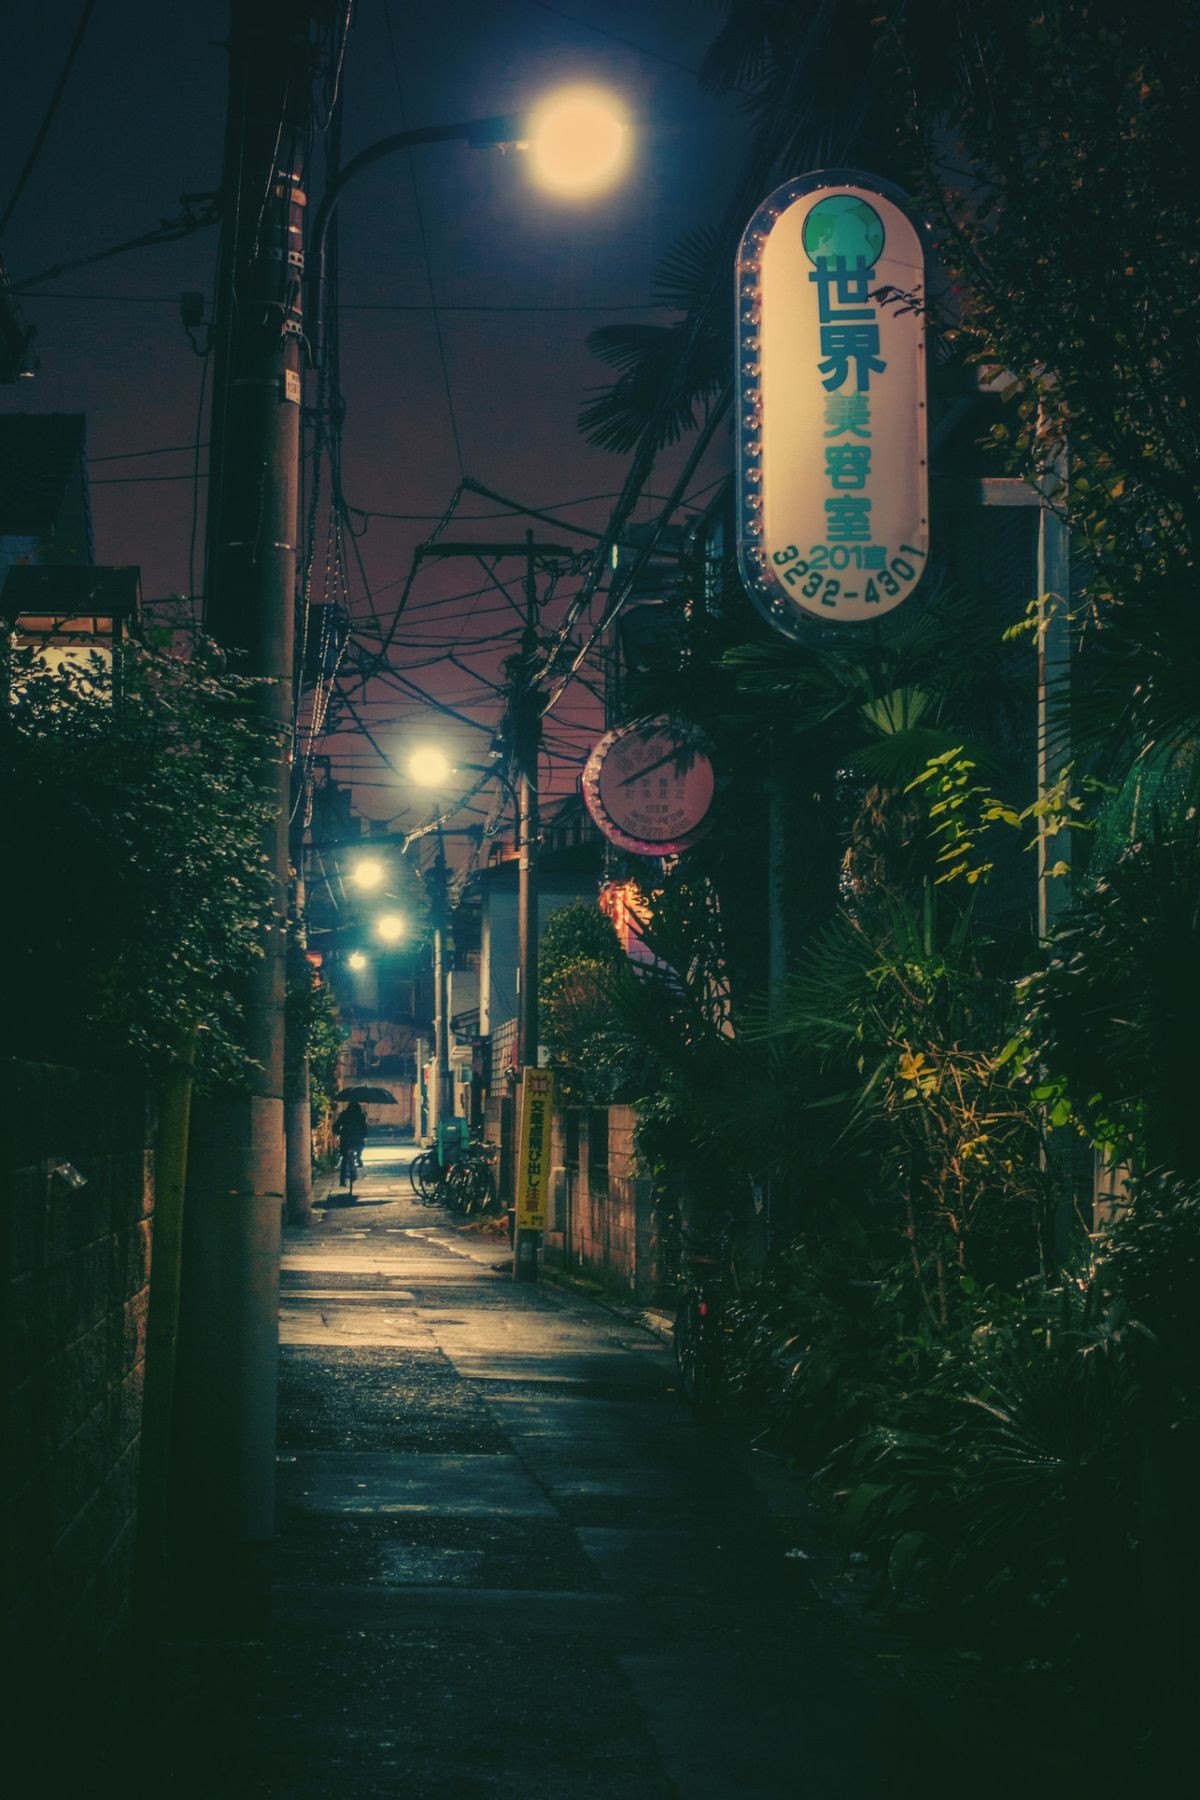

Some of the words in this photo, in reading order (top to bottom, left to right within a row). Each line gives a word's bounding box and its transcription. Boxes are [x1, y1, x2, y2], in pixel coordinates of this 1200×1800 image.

[809, 255, 887, 542] 世界美容室
[773, 544, 926, 607] 3232-4301
